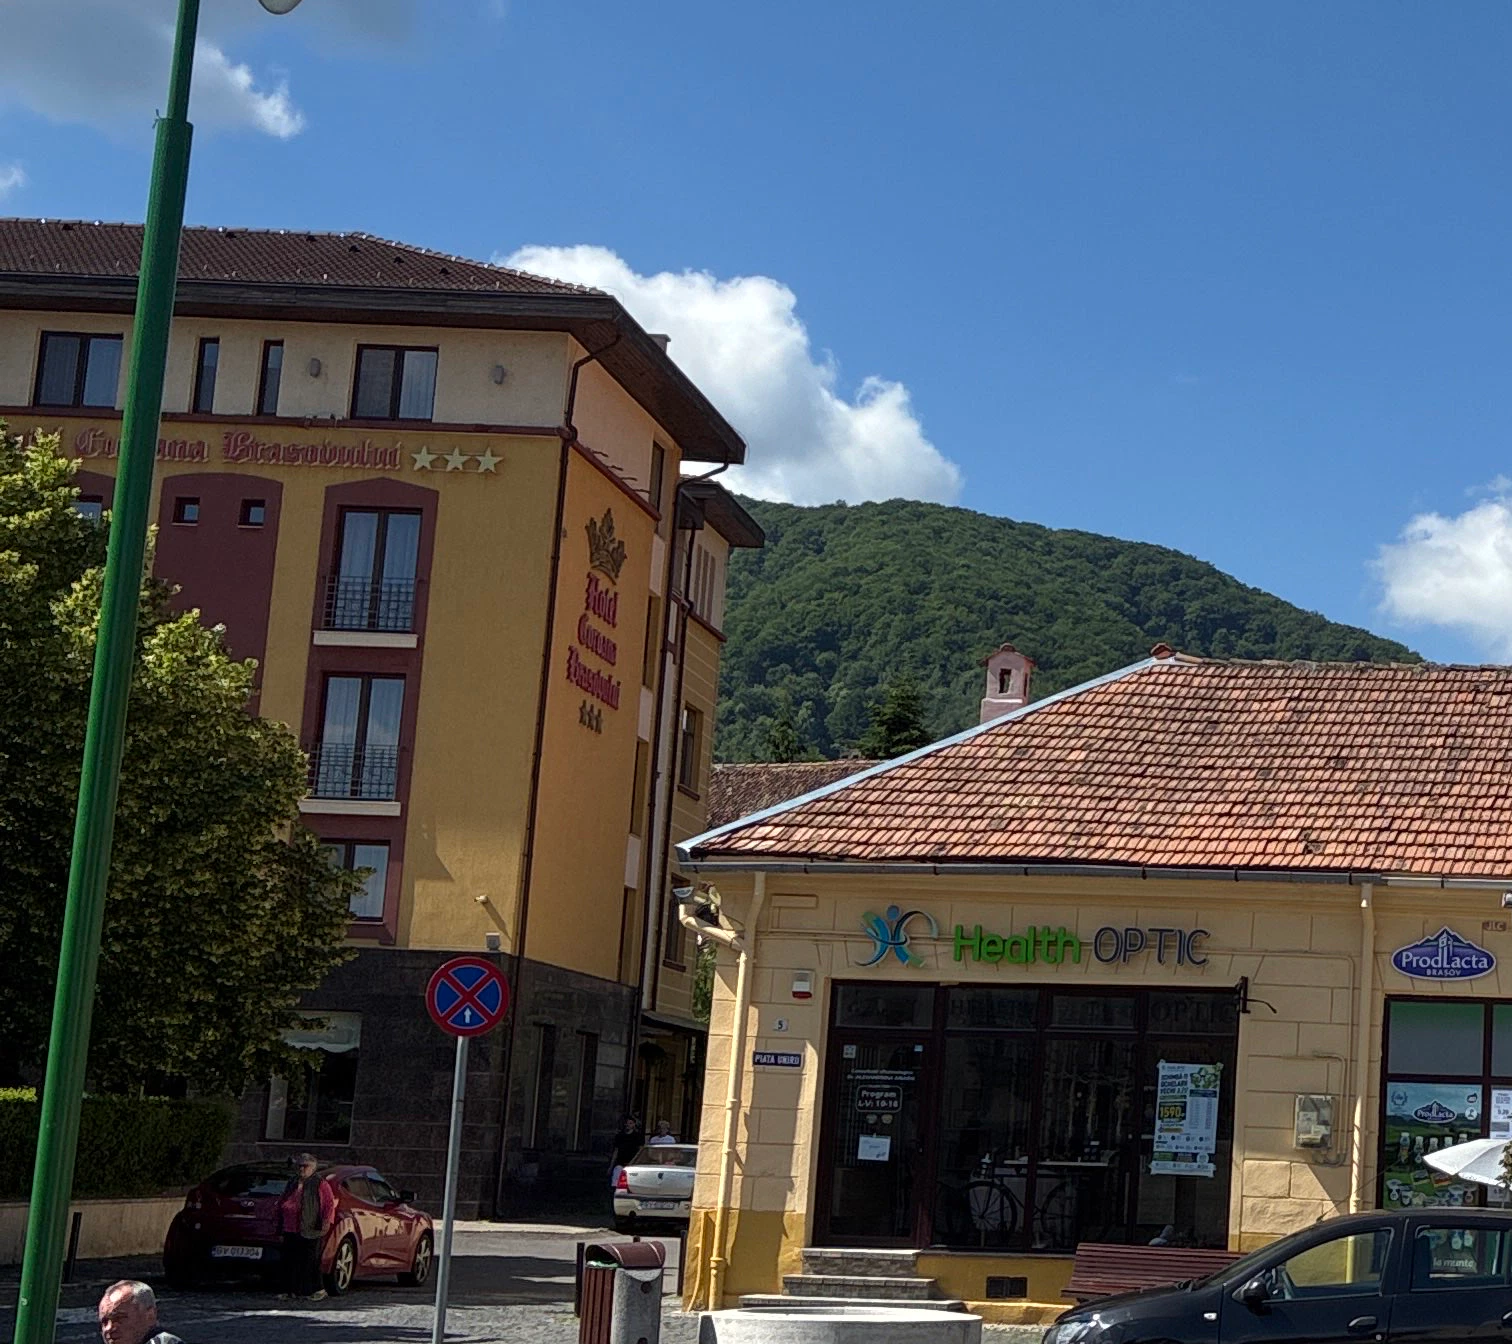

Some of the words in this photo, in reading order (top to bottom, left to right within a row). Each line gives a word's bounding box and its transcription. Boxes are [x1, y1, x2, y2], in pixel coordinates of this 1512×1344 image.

[585, 571, 619, 629] Hotel
[953, 924, 1082, 964] Health
[1093, 926, 1212, 967] OPTIC
[777, 1019, 784, 1030] 5
[861, 1090, 897, 1099] Program
